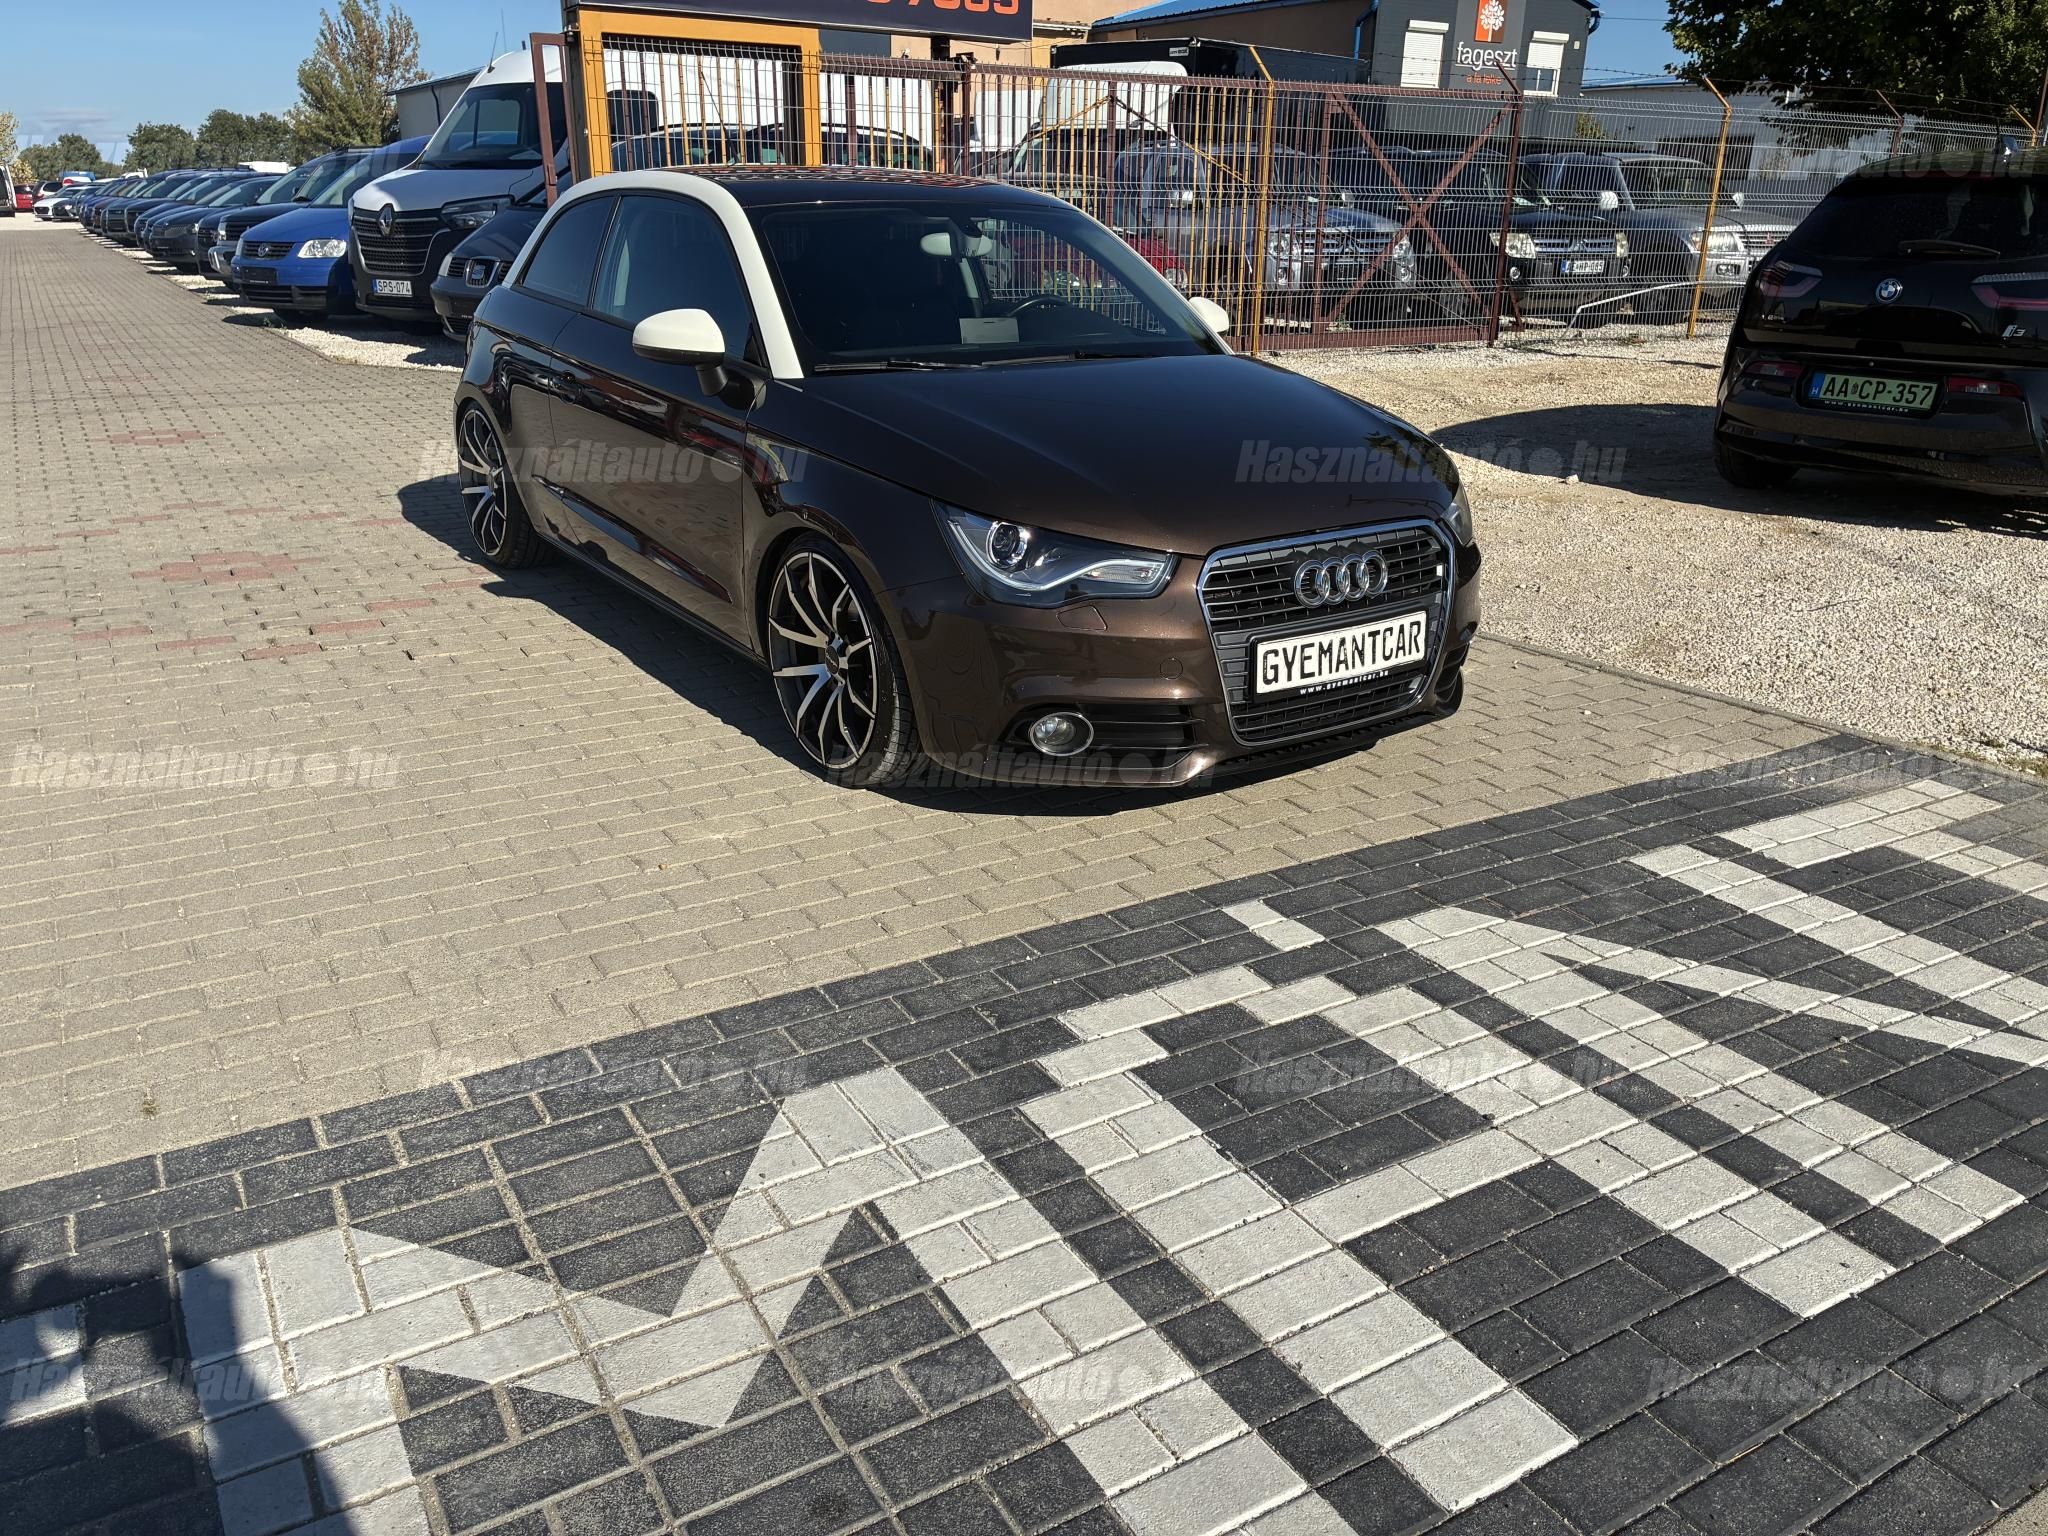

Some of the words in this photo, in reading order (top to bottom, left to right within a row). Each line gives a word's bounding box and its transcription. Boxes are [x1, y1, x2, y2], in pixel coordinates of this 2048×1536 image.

[1457, 41, 1518, 71] fageszt
[378, 280, 411, 294] SPS-074
[1822, 376, 1850, 398] AA
[1857, 379, 1935, 406] CP-357
[1262, 620, 1422, 686] GYEMANTCAR
